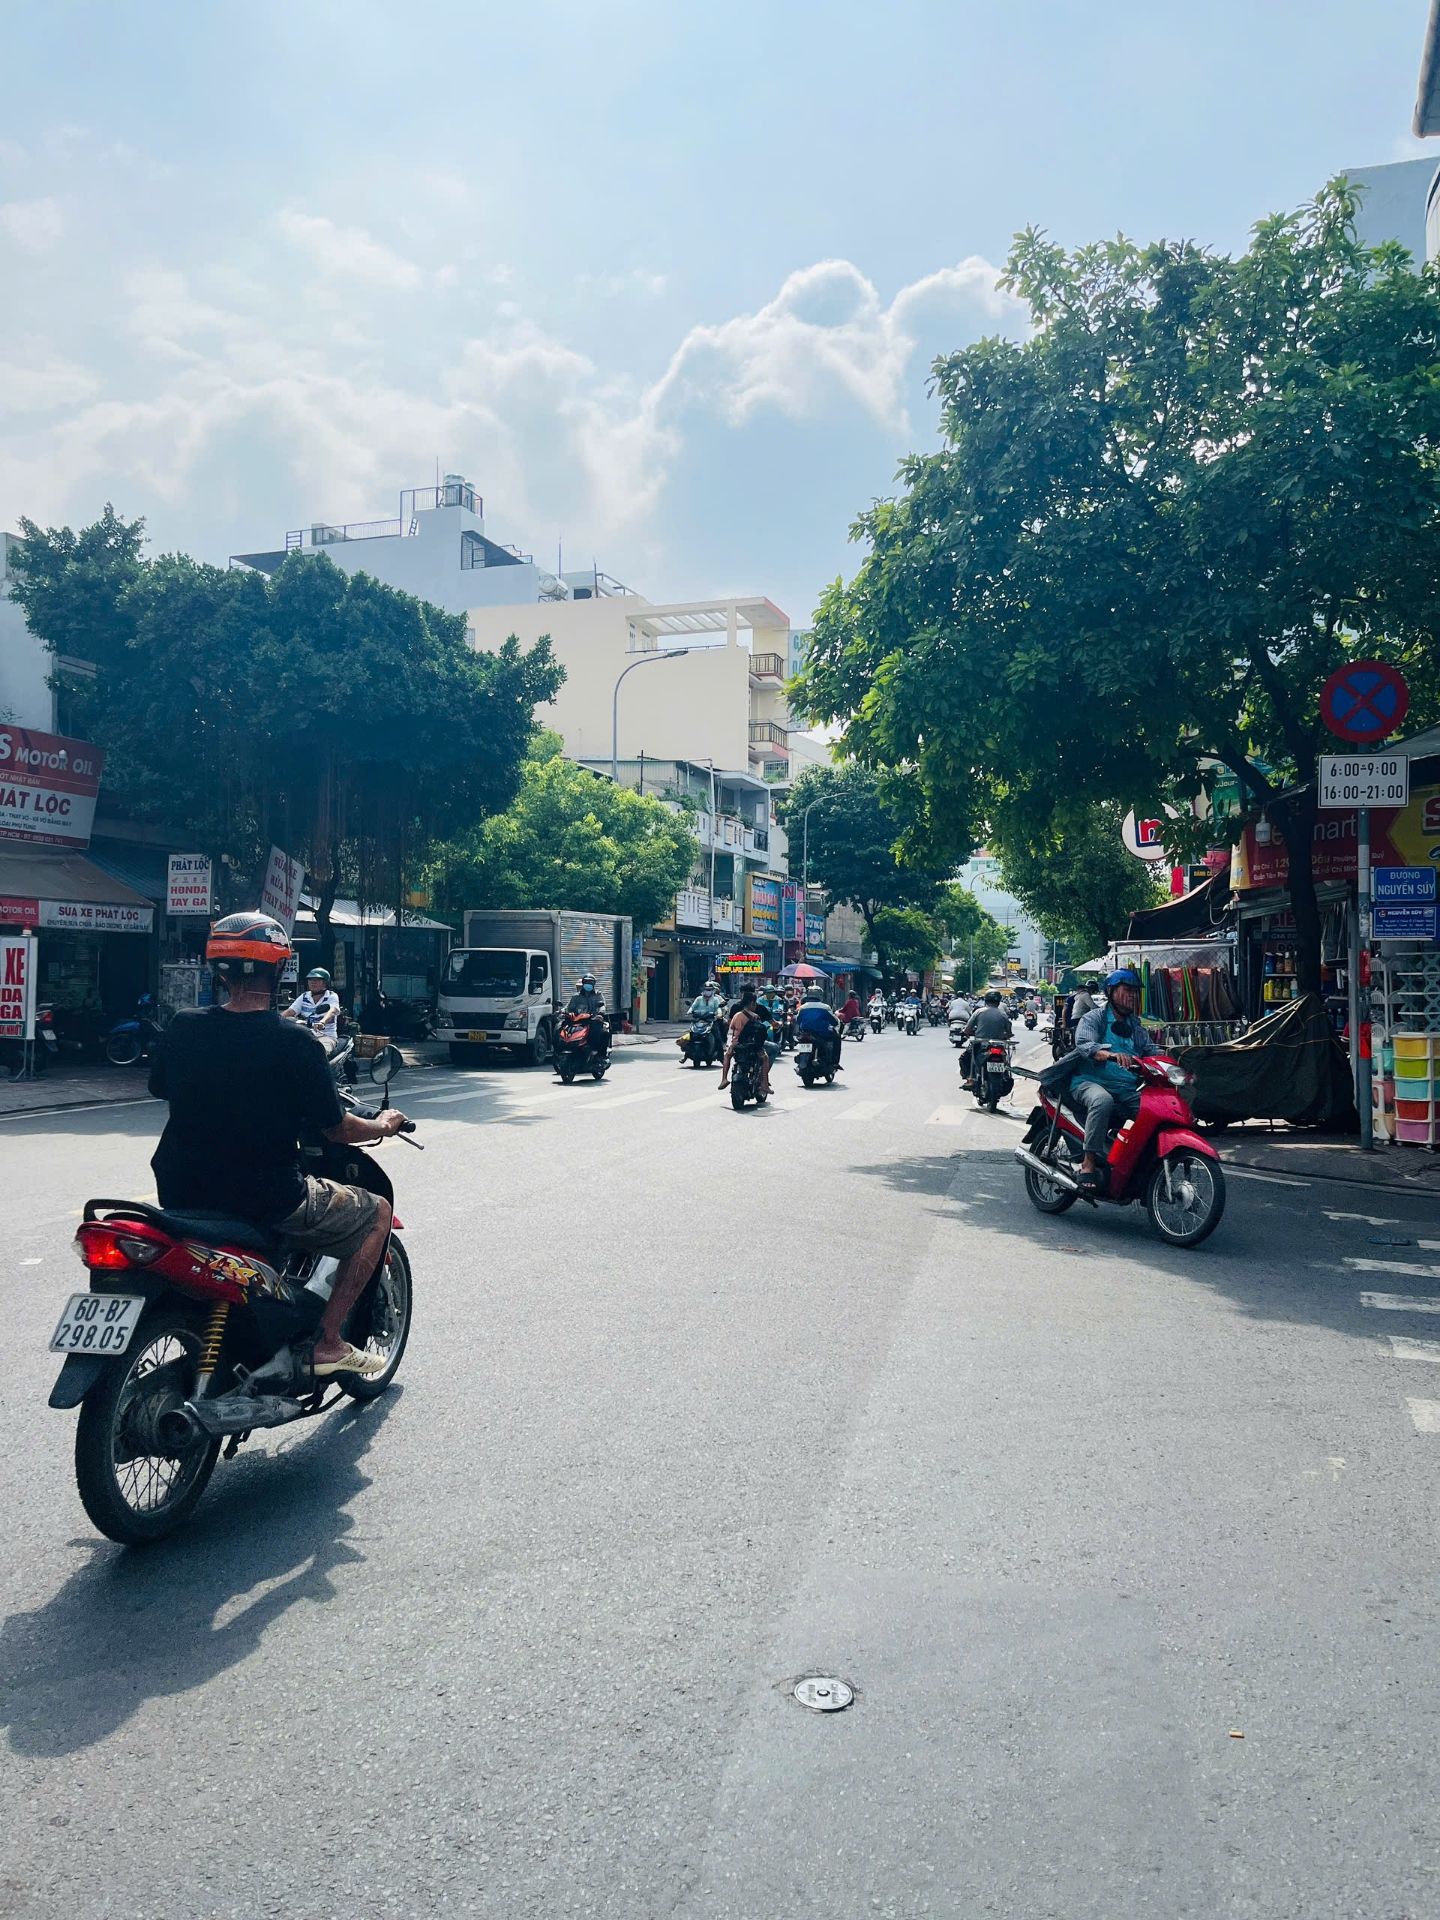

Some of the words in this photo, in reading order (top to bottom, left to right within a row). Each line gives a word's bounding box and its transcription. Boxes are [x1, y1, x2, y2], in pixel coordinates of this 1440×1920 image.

[15, 747, 68, 770] MOTOR
[72, 758, 94, 775] OIL
[1324, 784, 1403, 800] 16:00-21:00
[170, 885, 207, 894] HONDA
[1377, 880, 1414, 895] NGUYỄN
[1416, 880, 1435, 895] SÚY
[170, 898, 189, 906] TAY
[192, 898, 207, 906] GA
[24, 907, 37, 915] OIL
[80, 908, 93, 917] XE
[5, 948, 25, 985] XE
[74, 1298, 131, 1323] 60-B7
[55, 1324, 129, 1350] 298.05
